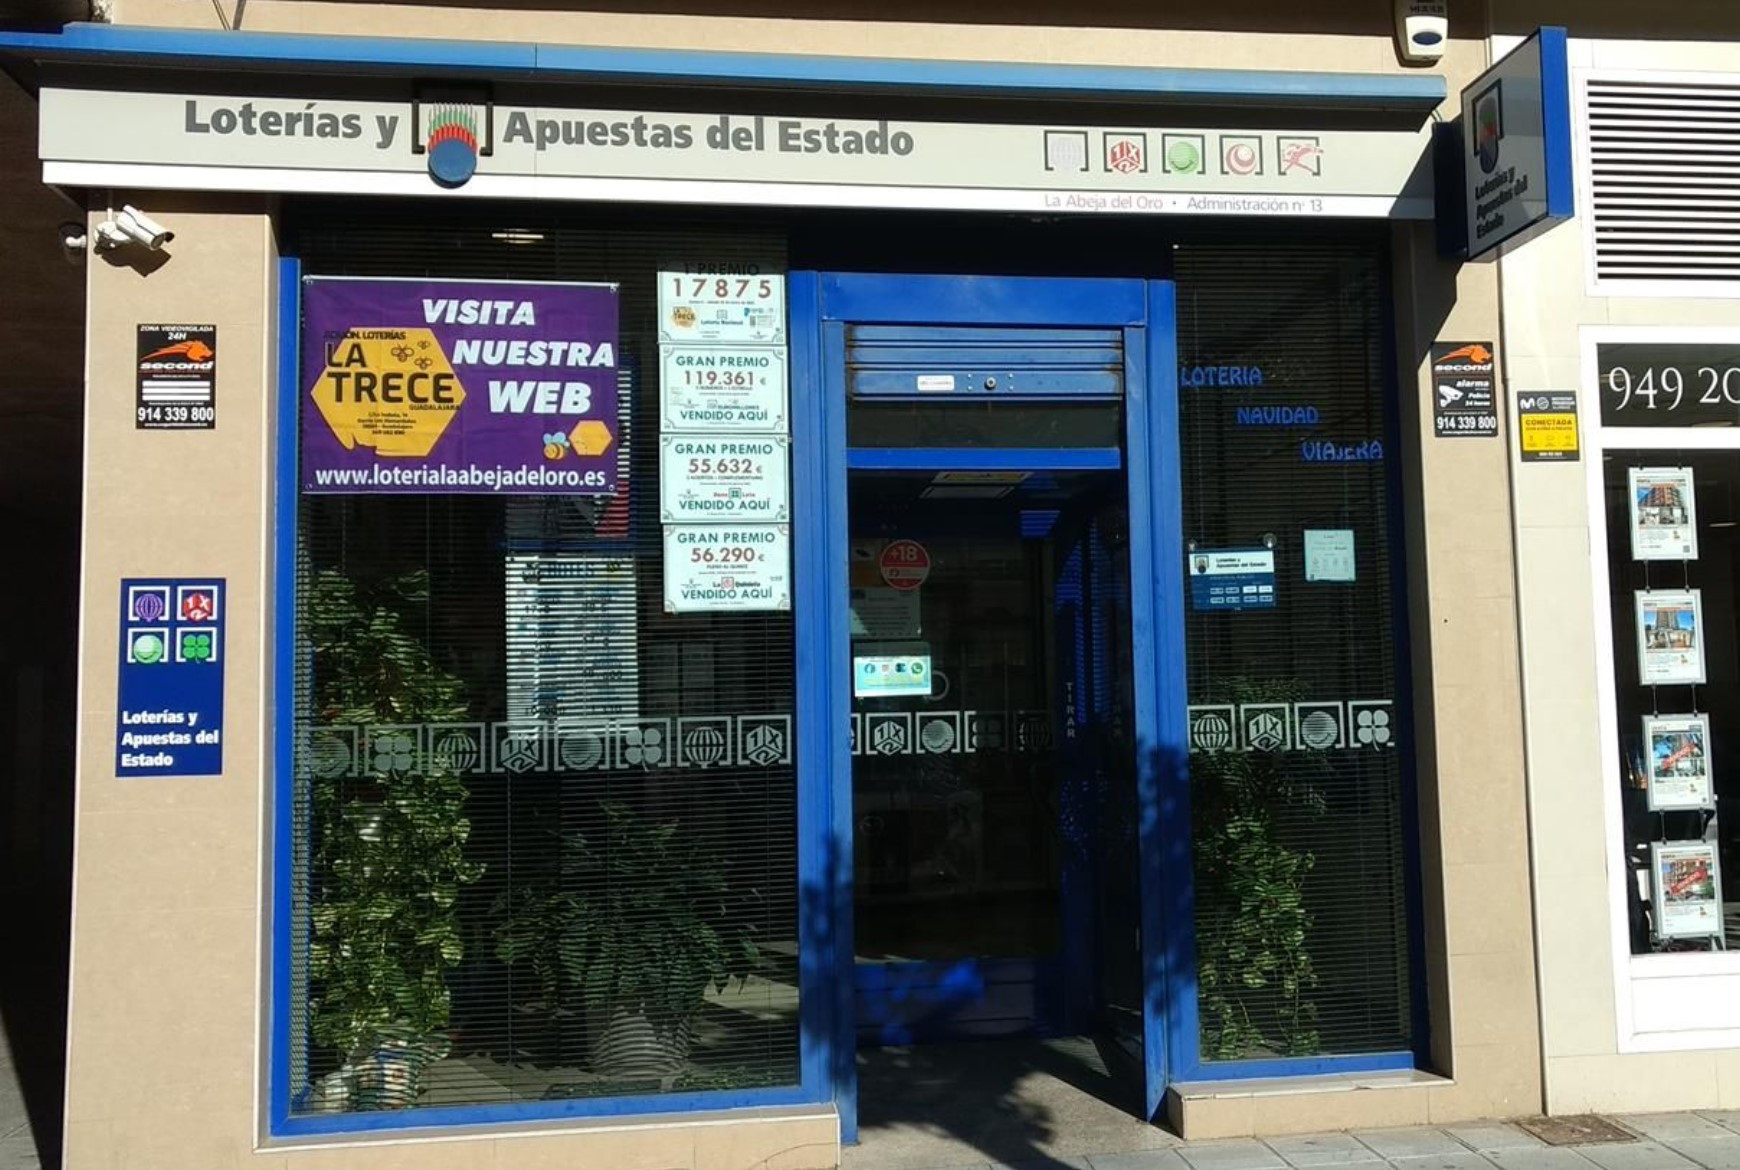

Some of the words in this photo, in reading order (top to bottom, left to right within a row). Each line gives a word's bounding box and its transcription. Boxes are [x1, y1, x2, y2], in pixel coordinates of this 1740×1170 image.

[185, 100, 362, 139] Loterías
[375, 114, 400, 150] y
[503, 111, 693, 152] Apuestas
[706, 114, 765, 152] del
[778, 118, 914, 156] Estado
[1044, 194, 1062, 208] La
[1065, 194, 1108, 212] Abeja
[1111, 194, 1133, 210] del
[1136, 195, 1164, 210] Oro
[1187, 196, 1291, 212] Administración
[1309, 199, 1324, 213] 13
[697, 263, 760, 276] PREMIO
[422, 298, 536, 326] VISITA
[327, 342, 367, 369] LA
[452, 339, 615, 368] NUESTRA
[675, 355, 715, 367] GRAN
[719, 356, 770, 368] PREMIO
[139, 361, 214, 370] second
[1434, 363, 1492, 372] second
[684, 369, 754, 386] 119.361
[1180, 366, 1263, 388] LOTERIA
[1456, 379, 1490, 388] alarma
[326, 371, 455, 404] TRECE
[1608, 366, 1684, 411] 949
[488, 380, 592, 415] WEB
[137, 406, 162, 422] 914
[164, 406, 188, 422] 339
[190, 406, 214, 422] 800
[680, 410, 734, 421] VENDIDO
[737, 408, 768, 421] AQUÍ
[1236, 406, 1320, 425] NAVIDAD
[1436, 416, 1456, 430] 914
[1457, 416, 1476, 430] 339
[1478, 416, 1497, 430] 800
[674, 443, 716, 455] GRAN
[720, 443, 773, 455] PREMIO
[1301, 440, 1384, 461] VIAJERA
[688, 458, 753, 474] 55.632
[315, 463, 606, 491] www.loterialaabejadeloro.es
[679, 500, 735, 510] VENDIDO
[739, 497, 770, 510] AQUÍ
[677, 532, 719, 544] GRAN
[723, 532, 776, 544] PREMIO
[690, 547, 756, 563] 56.290
[681, 589, 737, 600] VENDIDO
[741, 586, 773, 599] AQUÍ
[122, 709, 185, 725] Loterías
[187, 712, 198, 727] y
[1065, 682, 1076, 739] TIRAR
[121, 731, 192, 748] Apuestas
[195, 729, 220, 744] del
[121, 752, 174, 768] Estado
